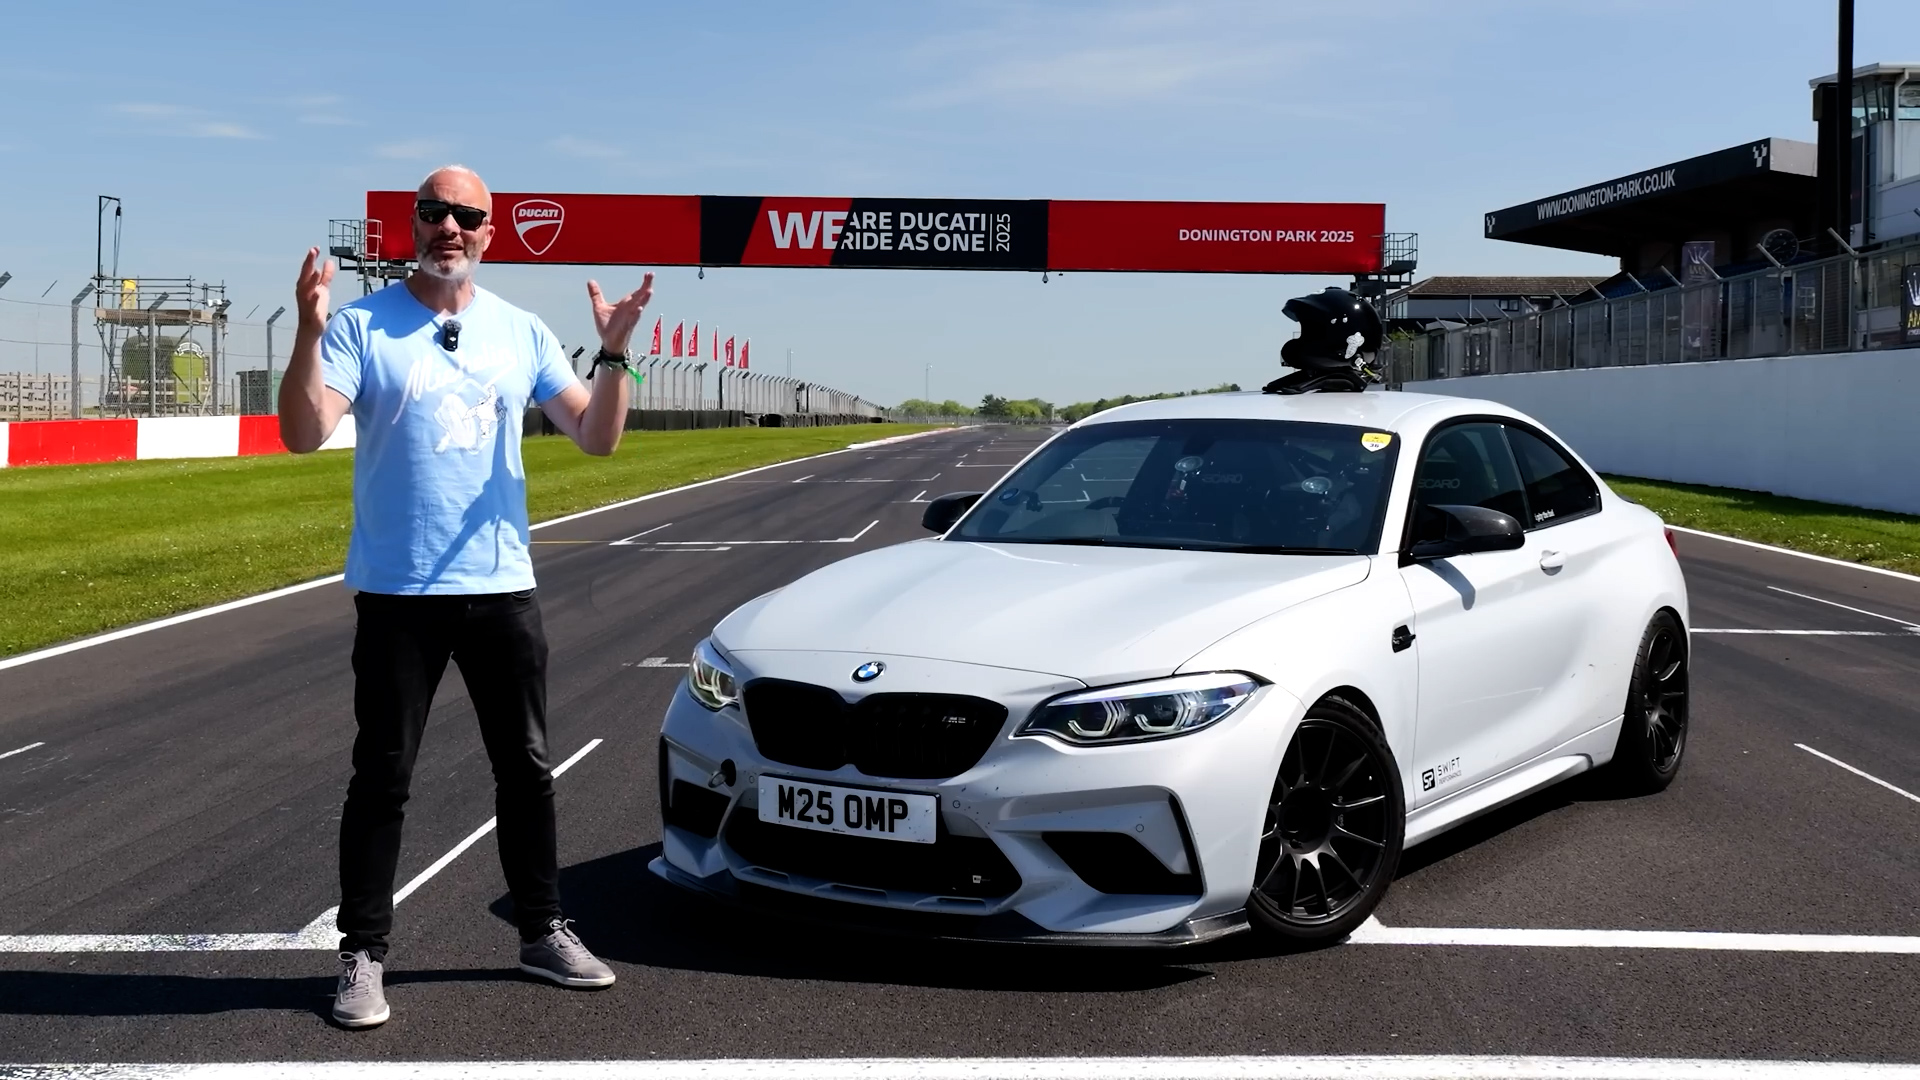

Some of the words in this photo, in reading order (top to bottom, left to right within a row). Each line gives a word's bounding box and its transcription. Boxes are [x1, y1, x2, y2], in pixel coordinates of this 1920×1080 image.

[1537, 169, 1676, 220] WWW.DONINGTON-PARK.CO.UK
[518, 208, 559, 218] DUCATI
[849, 211, 893, 230] ARE
[899, 212, 986, 231] DUCATI
[767, 210, 849, 249] WE
[996, 213, 1010, 252] 2025
[1179, 229, 1273, 242] DONINGTON
[1276, 230, 1317, 243] PARK
[1320, 230, 1355, 243] 2025
[841, 231, 893, 250] RIDE
[898, 233, 929, 251] AS
[933, 233, 985, 251] ONE
[1438, 757, 1460, 776] SWIFT
[778, 784, 834, 825] M25
